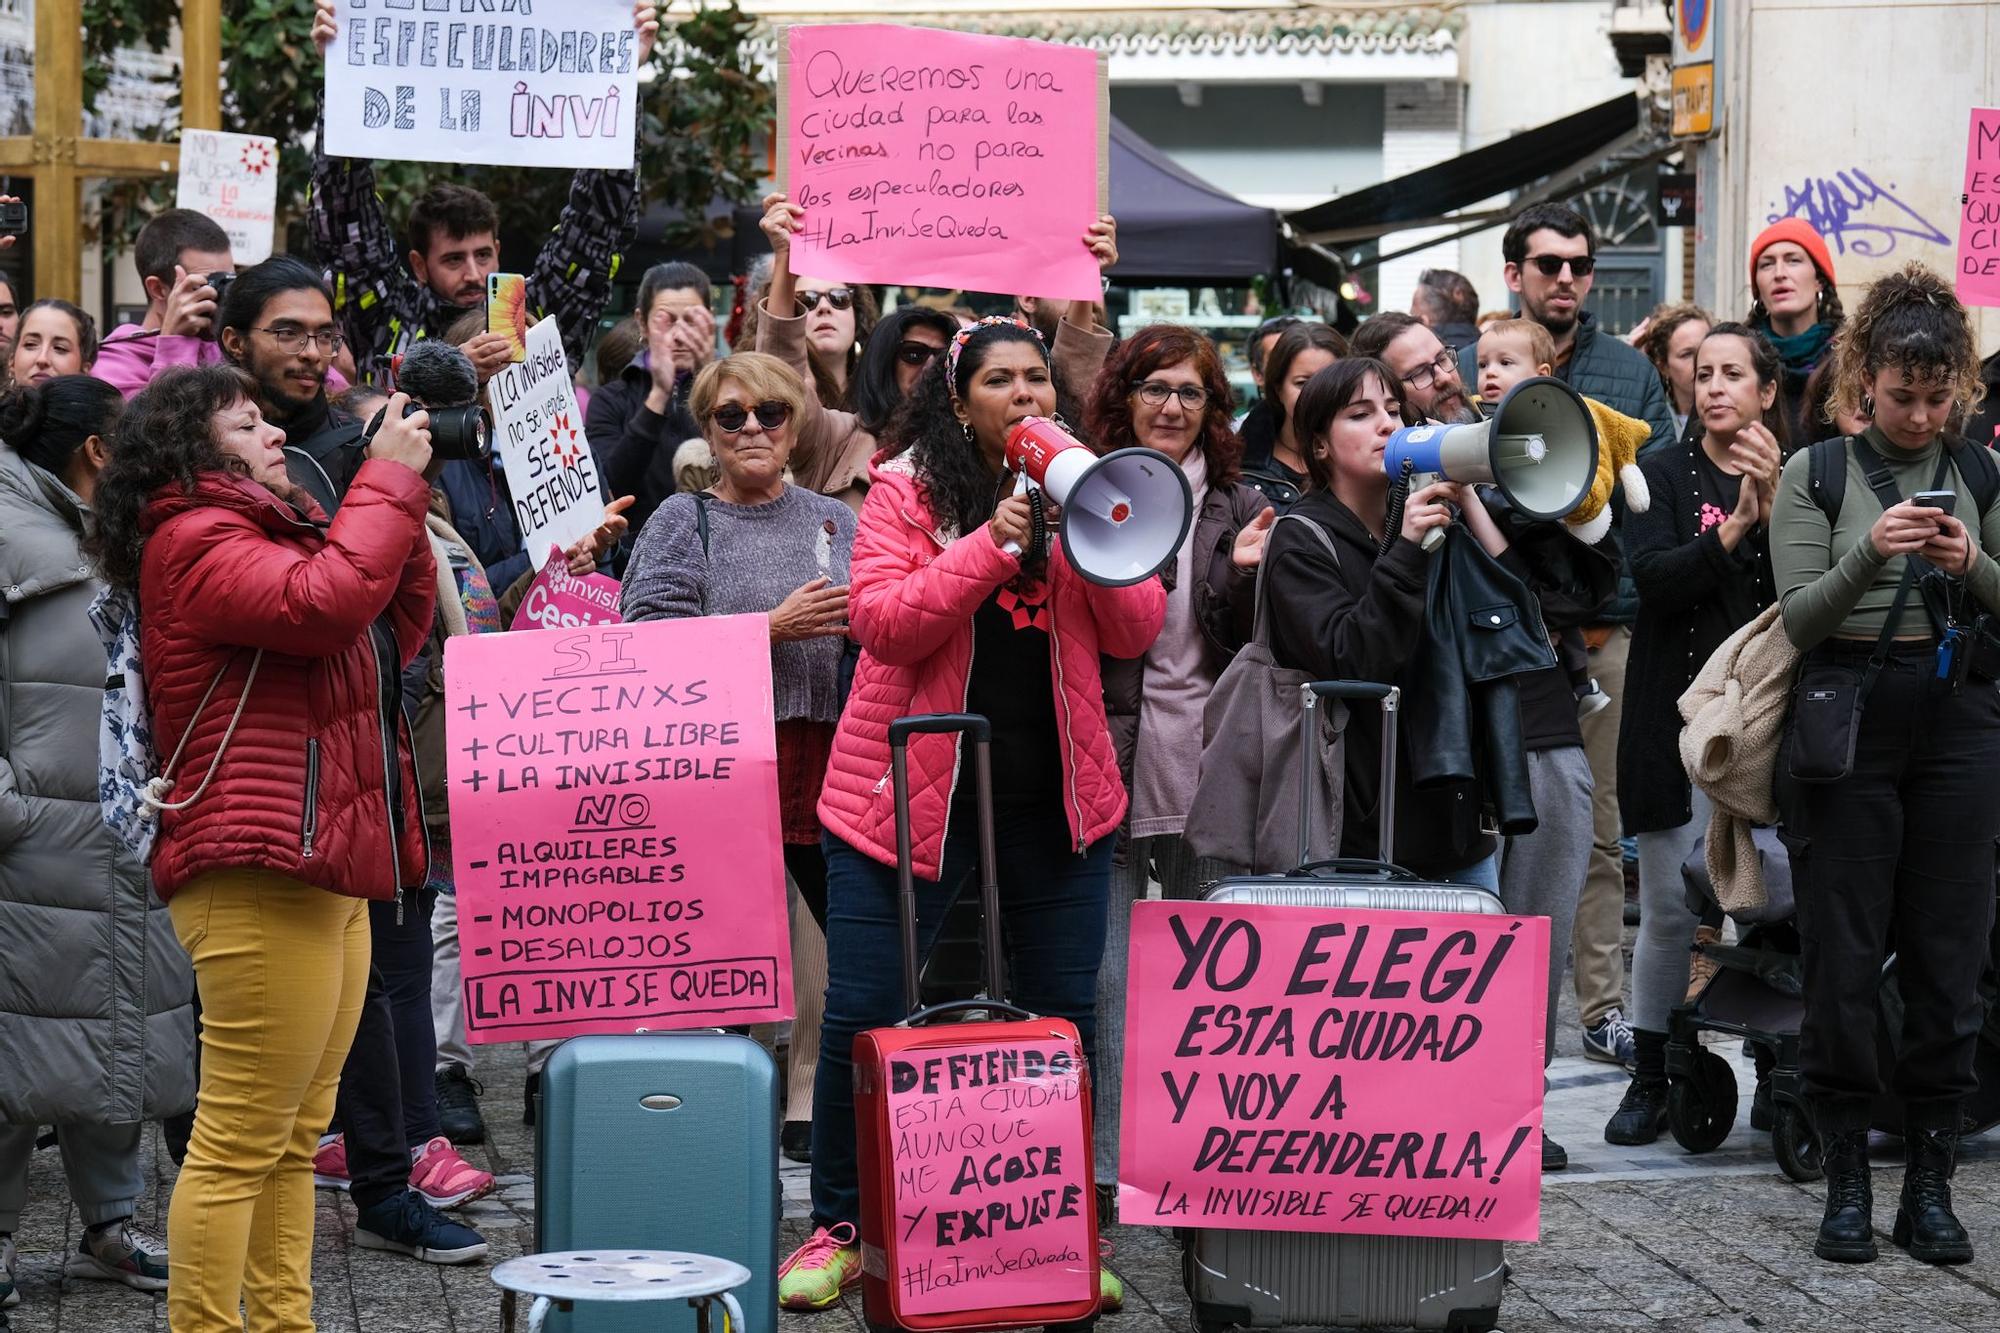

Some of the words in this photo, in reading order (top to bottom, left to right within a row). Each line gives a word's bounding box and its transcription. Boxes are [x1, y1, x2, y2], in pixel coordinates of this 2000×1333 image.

[347, 17, 635, 73] ESPECULADORES
[363, 86, 416, 129] DE
[440, 87, 481, 131] LA
[1007, 101, 1045, 125] las
[918, 142, 955, 161] no
[798, 185, 832, 209] los
[1963, 256, 2000, 275] DE
[507, 419, 525, 448] no
[525, 410, 542, 433] se
[527, 436, 557, 478] SE
[516, 454, 597, 537] DEFIENDE
[553, 632, 637, 676] SI
[499, 680, 708, 719] VECINXS
[496, 727, 629, 757] CULTURA
[643, 721, 740, 748] LIBRE
[498, 766, 540, 793] LA
[555, 757, 736, 790] INVISIBLE
[574, 793, 650, 826] NO
[497, 836, 678, 864] ALQUILERES
[500, 864, 686, 889] IMPAGABLES
[502, 899, 704, 930] MONOPOLIOS
[501, 931, 692, 962] DESALOJOS
[1168, 914, 1262, 992] YO
[1285, 922, 1523, 1004] ELEGÍ
[475, 982, 521, 1019] LA
[670, 969, 768, 1001] QUEDA
[1175, 1005, 1295, 1058] ESTA
[1308, 1008, 1483, 1062] CIUDAD
[891, 1048, 1074, 1094] DEFIENDO
[896, 1096, 965, 1130] ESTA
[980, 1078, 1079, 1113] CIUDAD
[1160, 1071, 1199, 1123] Y
[1218, 1072, 1300, 1121] VOY
[1310, 1074, 1347, 1120] A
[896, 1118, 1035, 1161] AUNQUE
[1193, 1126, 1532, 1185] DEFENDERLA!
[899, 1164, 939, 1200] ME
[949, 1145, 1062, 1195] ACOSE
[903, 1206, 928, 1242] Y
[1202, 1186, 1333, 1218] INVISIBLE
[1341, 1194, 1380, 1222] SE
[1384, 1194, 1498, 1223] QUEDA!!
